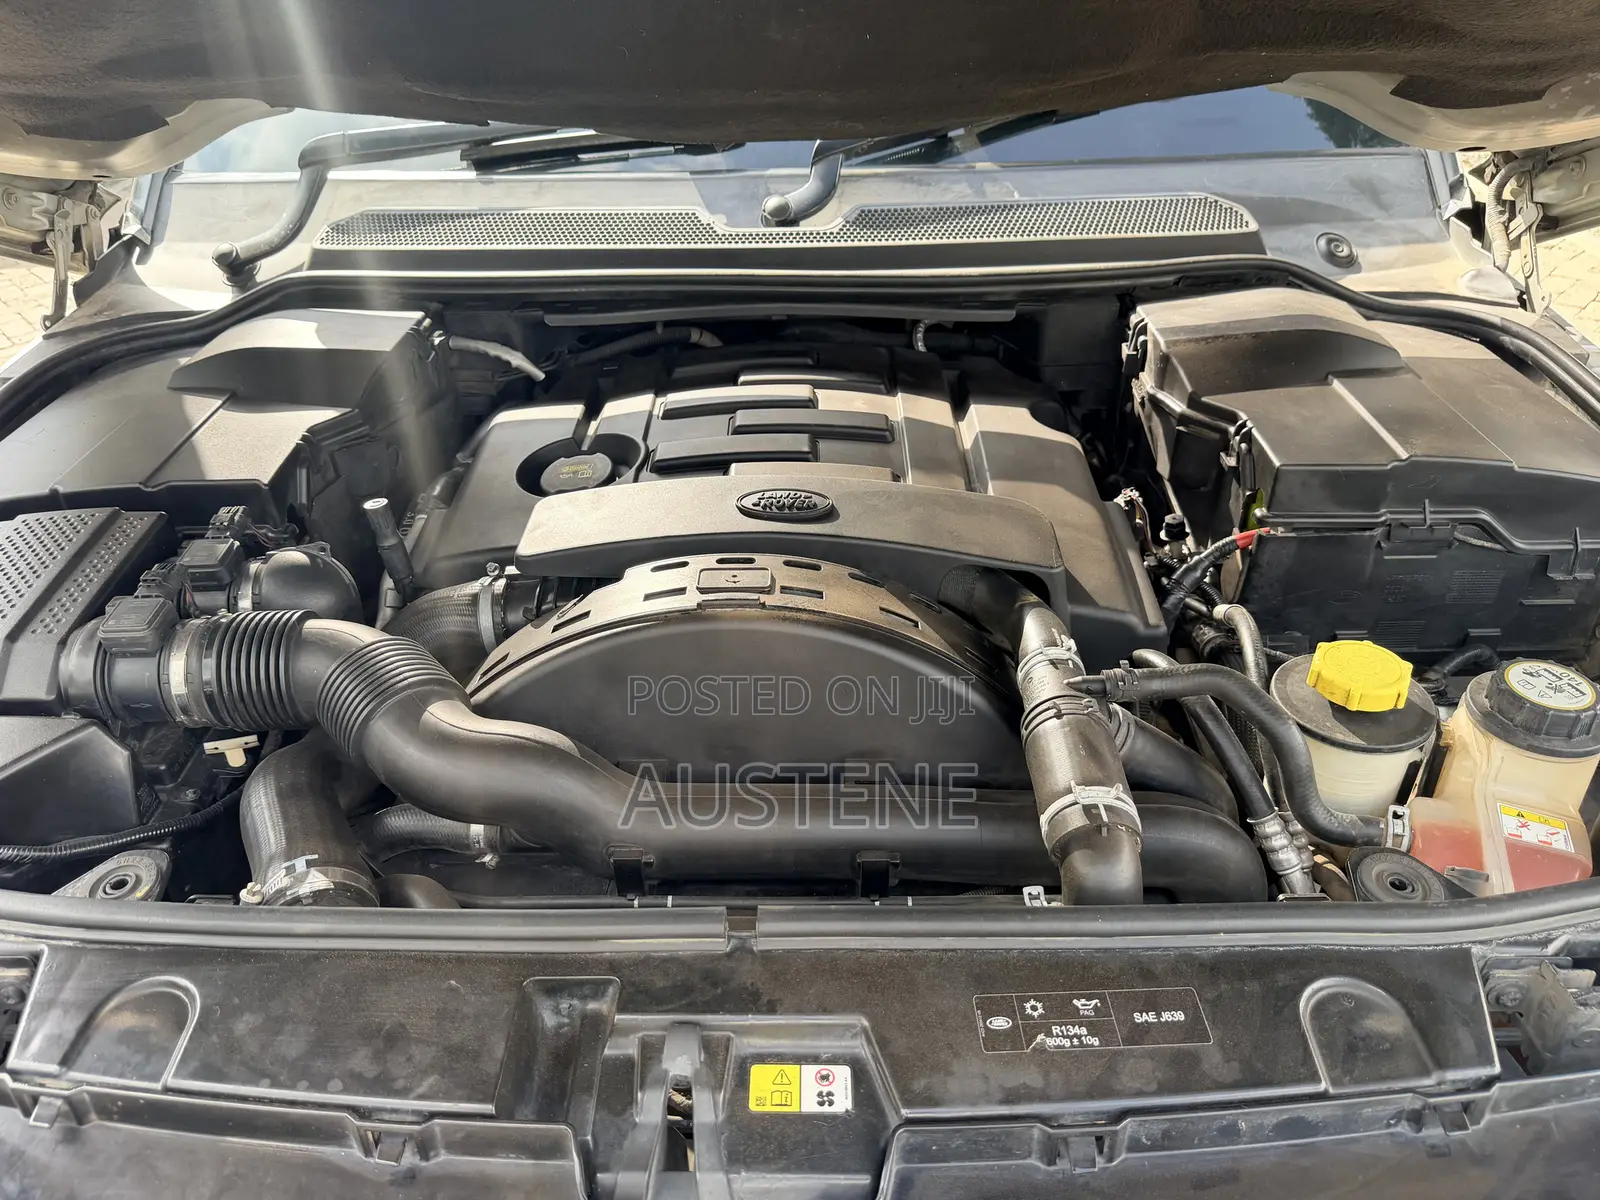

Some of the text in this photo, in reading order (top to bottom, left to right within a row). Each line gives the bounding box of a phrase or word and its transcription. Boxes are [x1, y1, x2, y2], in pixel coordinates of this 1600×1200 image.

[757, 492, 803, 500] LAND
[760, 500, 818, 511] ROVER
[1133, 1010, 1185, 1023] SAE J639
[1051, 1025, 1087, 1036] R134a
[1046, 1037, 1071, 1047] 600g
[1081, 1036, 1099, 1046] 10g
